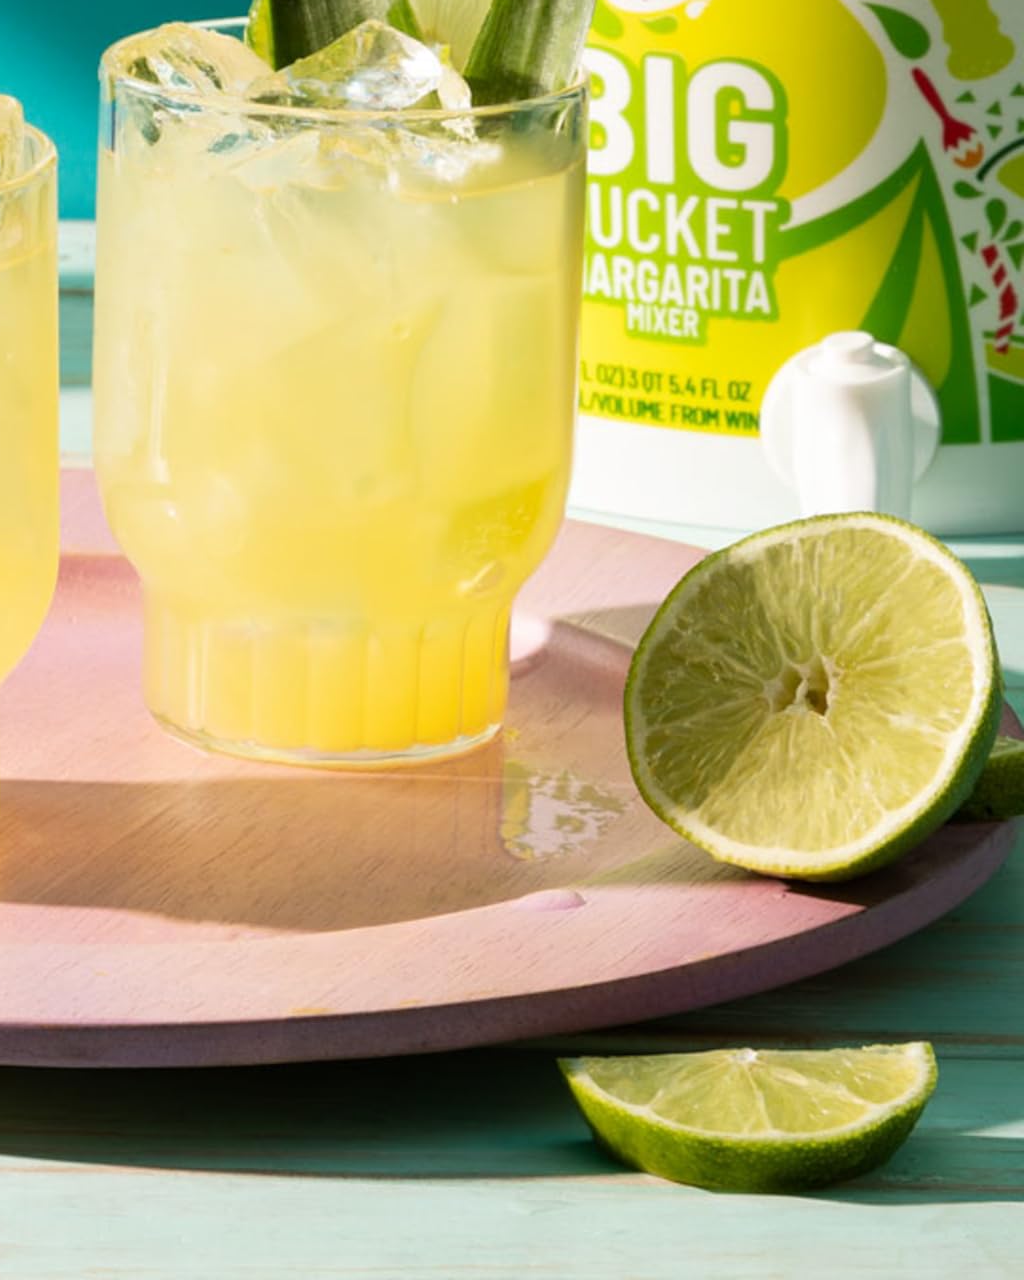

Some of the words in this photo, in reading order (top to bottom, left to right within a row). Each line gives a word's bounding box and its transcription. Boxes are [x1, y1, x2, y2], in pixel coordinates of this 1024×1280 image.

[584, 46, 775, 192] BIG
[588, 182, 778, 263] UCKET
[626, 301, 699, 338] MIXER
[642, 370, 662, 392] QT
[669, 375, 696, 397] 5.4
[701, 378, 720, 400] FL
[728, 381, 752, 402] OZ
[579, 388, 665, 422] L/VOLUME
[669, 404, 720, 427] FROM
[726, 410, 760, 431] WIN
